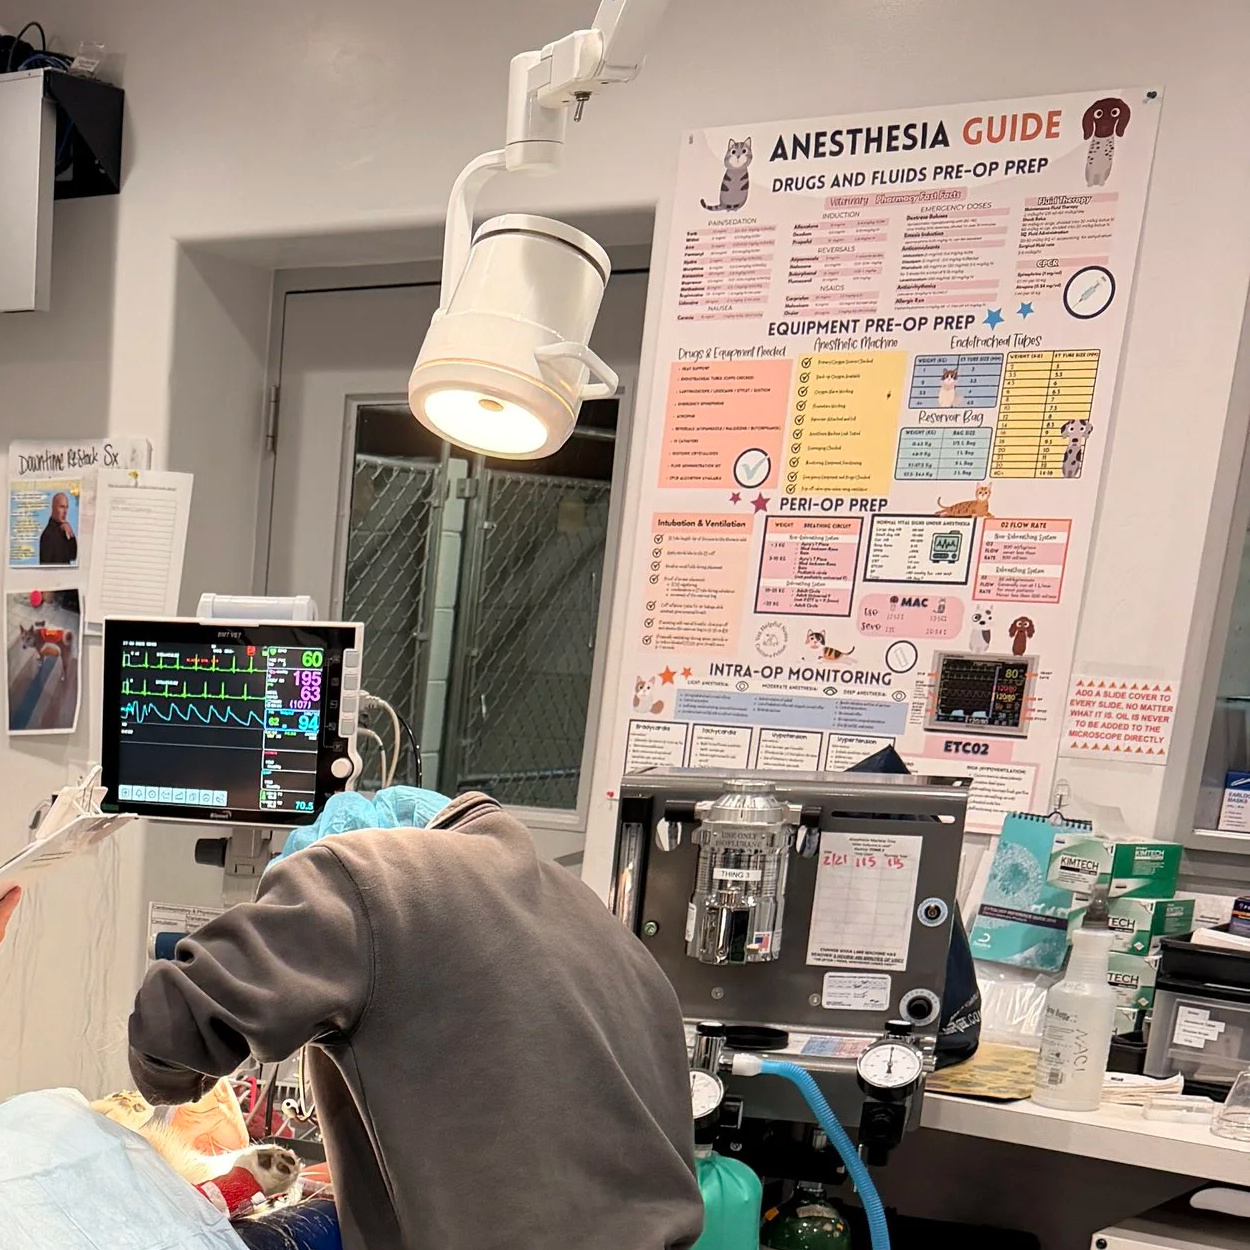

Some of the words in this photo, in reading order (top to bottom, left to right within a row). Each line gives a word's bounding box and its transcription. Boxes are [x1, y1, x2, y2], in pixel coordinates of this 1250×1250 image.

[769, 120, 950, 163] ANESTHESIA
[962, 110, 1063, 146] GUIDE
[771, 174, 826, 193] DRUGS
[830, 171, 866, 189] AND
[870, 167, 927, 185] FLUIDS
[932, 161, 999, 182] PRE-OP
[1004, 157, 1049, 176] PREP
[875, 193, 920, 204] Pharmacy
[919, 191, 938, 201] Fast
[921, 204, 966, 212] EMERGENCY
[967, 202, 992, 210] DOSES
[822, 211, 860, 220] INDUCTION
[708, 218, 757, 226] PAIN/SEDATION
[1036, 259, 1059, 268] CPCR
[768, 319, 860, 336] EQUIPMENT
[864, 316, 927, 333] PRE-OP
[933, 315, 975, 331] PREP
[814, 337, 857, 351] Anesthetic
[1013, 333, 1043, 348] Tubes
[678, 347, 704, 363] Drugs
[705, 348, 712, 358] &
[756, 345, 787, 357] Needed
[963, 409, 984, 428] Bag
[18, 449, 65, 475] Downtime
[103, 443, 120, 466] Sx
[780, 497, 844, 512] PERI-OP
[849, 498, 888, 512] PREP
[658, 519, 695, 527] Intubation
[705, 519, 746, 528] Ventilation
[901, 598, 929, 608] MAC
[861, 622, 882, 631] Sevo
[302, 651, 323, 668] 60
[293, 671, 321, 686] 195
[709, 663, 784, 680] INTRA-OP
[788, 667, 893, 686] MONITORING
[1005, 668, 1019, 679] 80
[300, 686, 321, 701] 63
[1103, 691, 1127, 699] SLIDE
[1128, 692, 1157, 701] COVER
[289, 700, 311, 709] (107)
[1070, 700, 1096, 708] EVERY
[1140, 704, 1174, 712] MATTER
[299, 715, 319, 731] 94
[1141, 714, 1169, 723] NEVER
[636, 724, 671, 732] Bradycardia
[1100, 722, 1129, 731] ADDED
[1131, 724, 1143, 732] TO
[1145, 725, 1161, 733] THE
[1069, 730, 1122, 740] MICROSCOPE
[1124, 734, 1165, 744] DIRECTLY
[295, 801, 314, 811] 70.5
[722, 831, 736, 839] USE
[822, 853, 847, 866] 2/21
[1060, 857, 1099, 871] KIMTECH
[721, 870, 744, 878] THING
[1108, 972, 1140, 984] TECH
